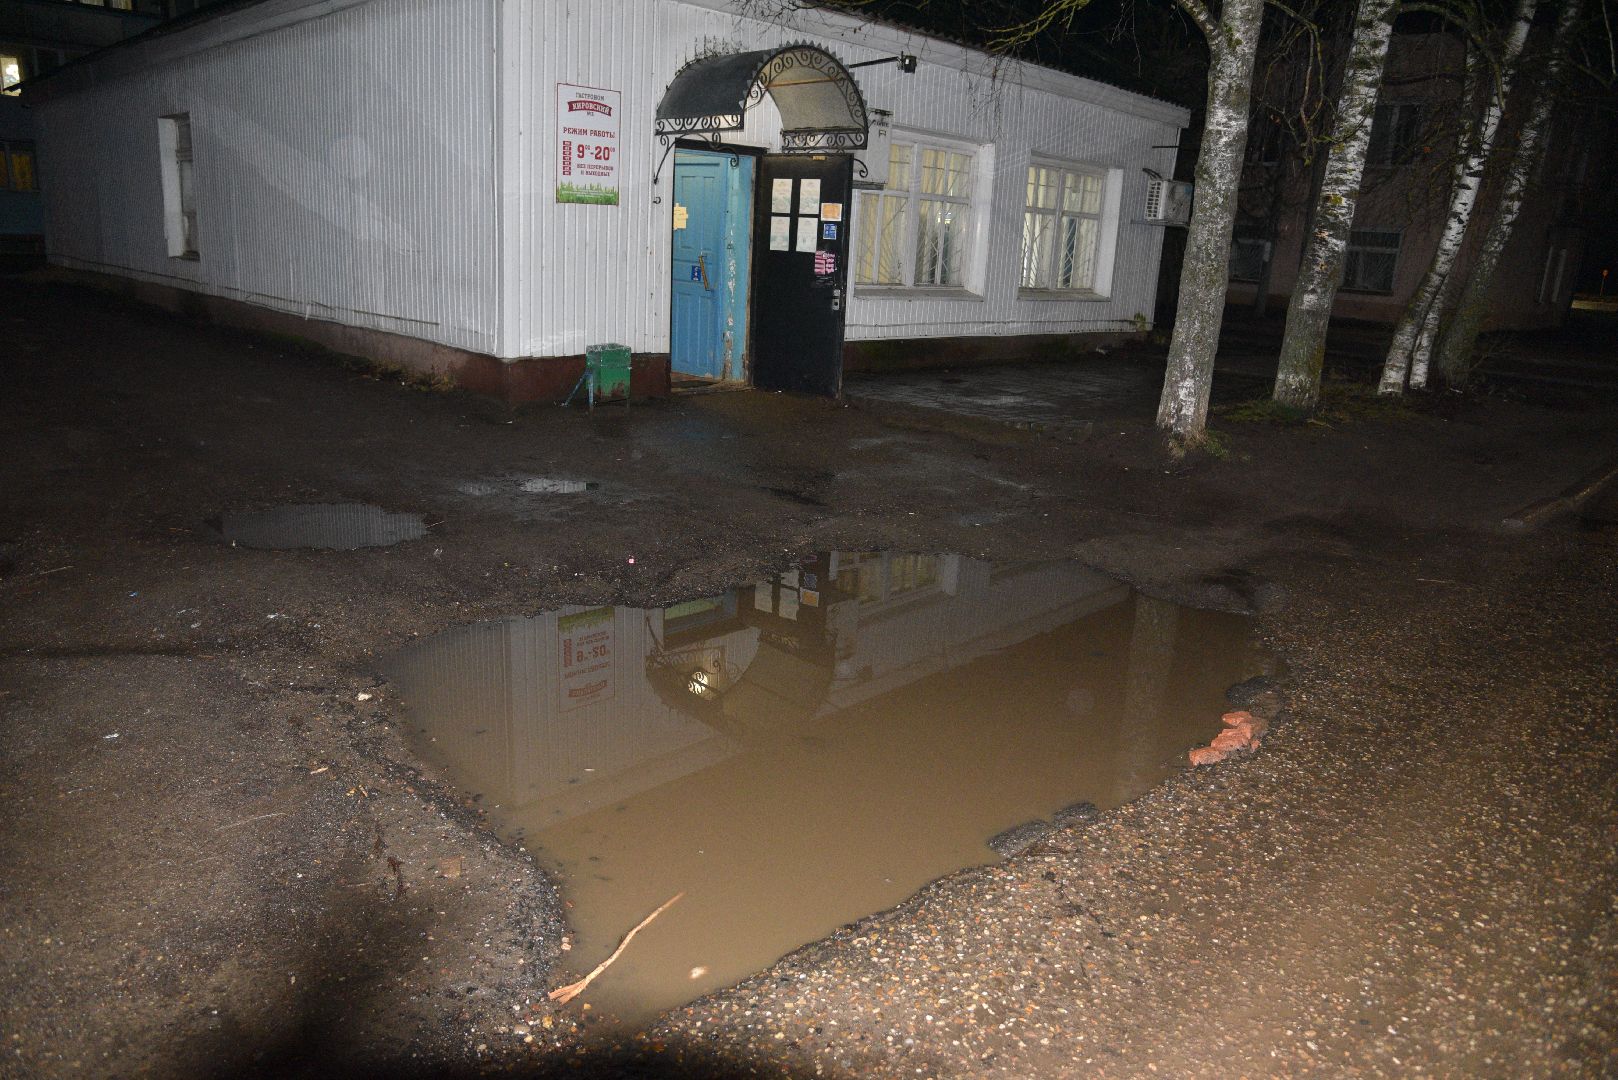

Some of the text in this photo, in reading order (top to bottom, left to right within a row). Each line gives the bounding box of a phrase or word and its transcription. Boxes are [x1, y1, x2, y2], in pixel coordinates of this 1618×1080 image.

[575, 92, 605, 101] ГАСТРОНОМ
[572, 101, 610, 115] КИРОВСКИЙ
[563, 127, 616, 139] РЕЖИМ РАБОТЫ
